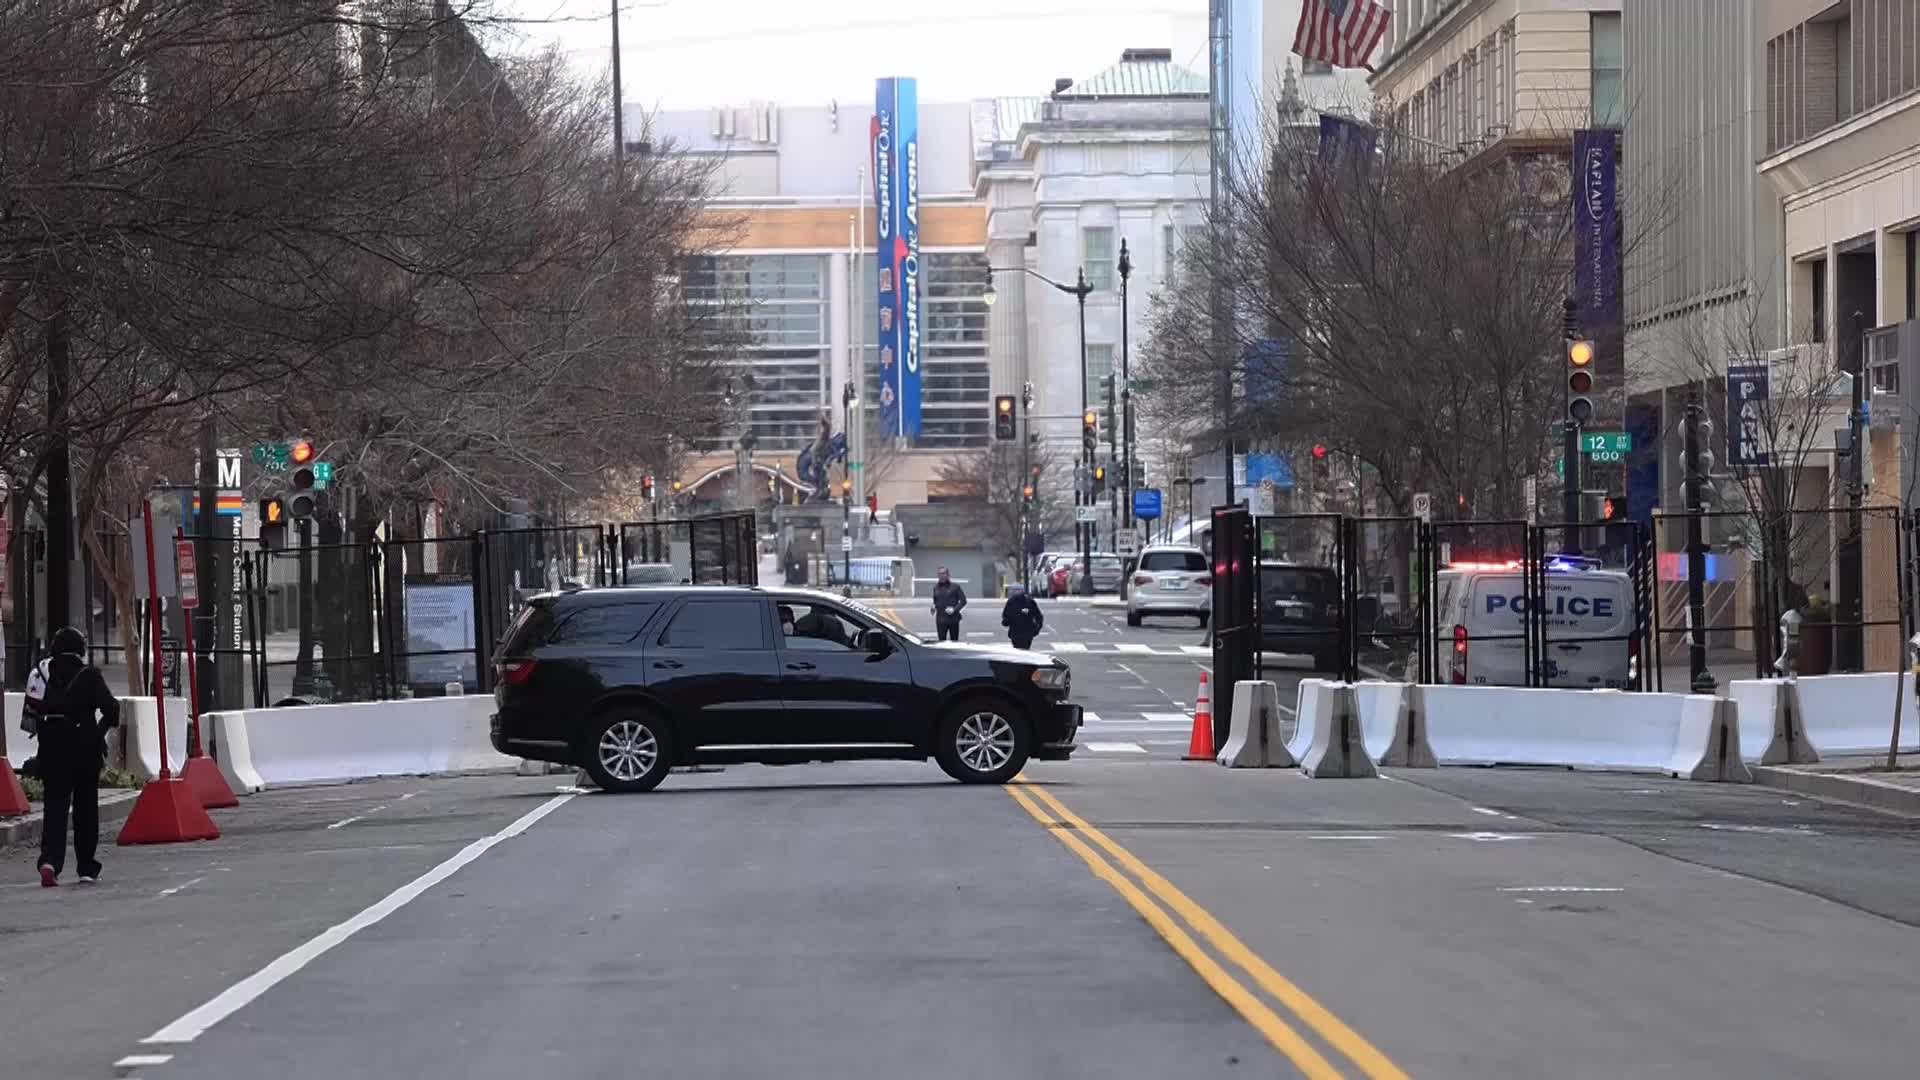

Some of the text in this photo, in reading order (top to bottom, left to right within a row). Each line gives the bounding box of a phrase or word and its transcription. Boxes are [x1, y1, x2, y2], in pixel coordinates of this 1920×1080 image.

[907, 141, 918, 225] Arena
[1589, 435, 1606, 449] 12
[217, 457, 241, 488] M
[232, 516, 242, 553] Metro
[233, 603, 243, 650] Station
